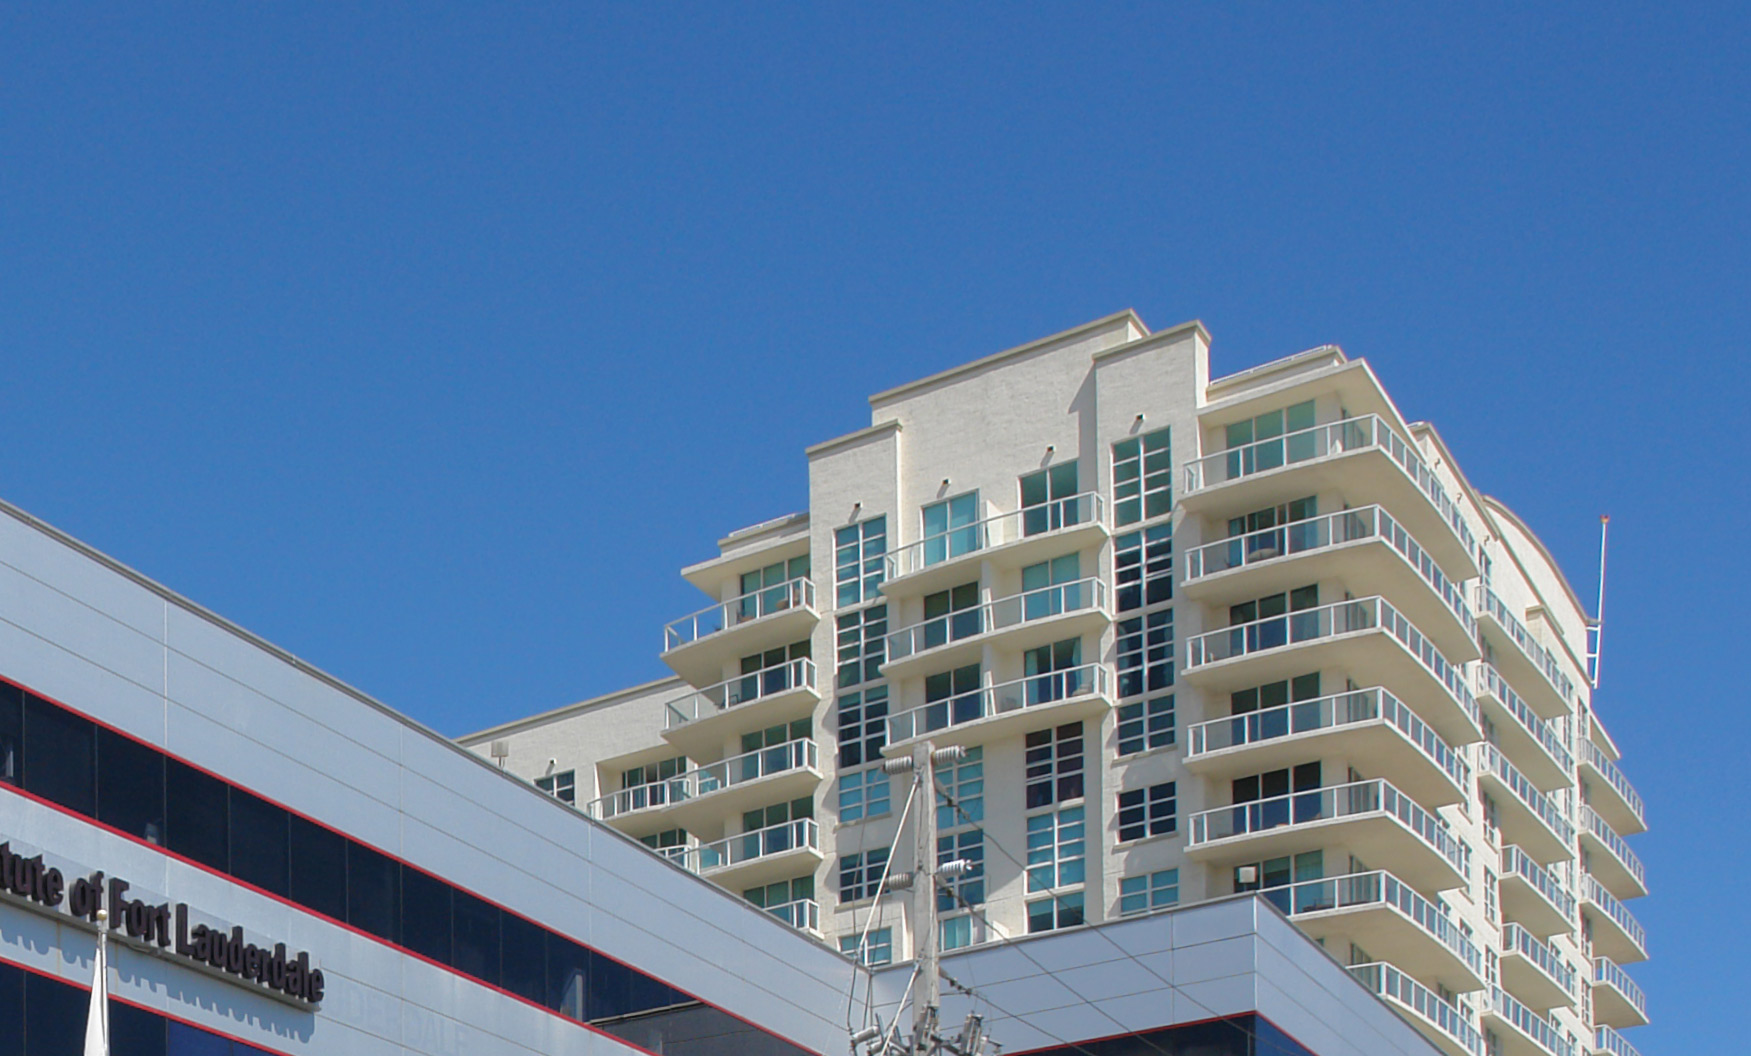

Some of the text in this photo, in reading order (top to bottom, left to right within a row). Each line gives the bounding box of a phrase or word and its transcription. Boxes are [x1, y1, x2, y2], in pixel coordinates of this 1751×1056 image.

[69, 870, 104, 922] of
[108, 877, 171, 947] Fort
[176, 903, 324, 1003] Lauderdale
